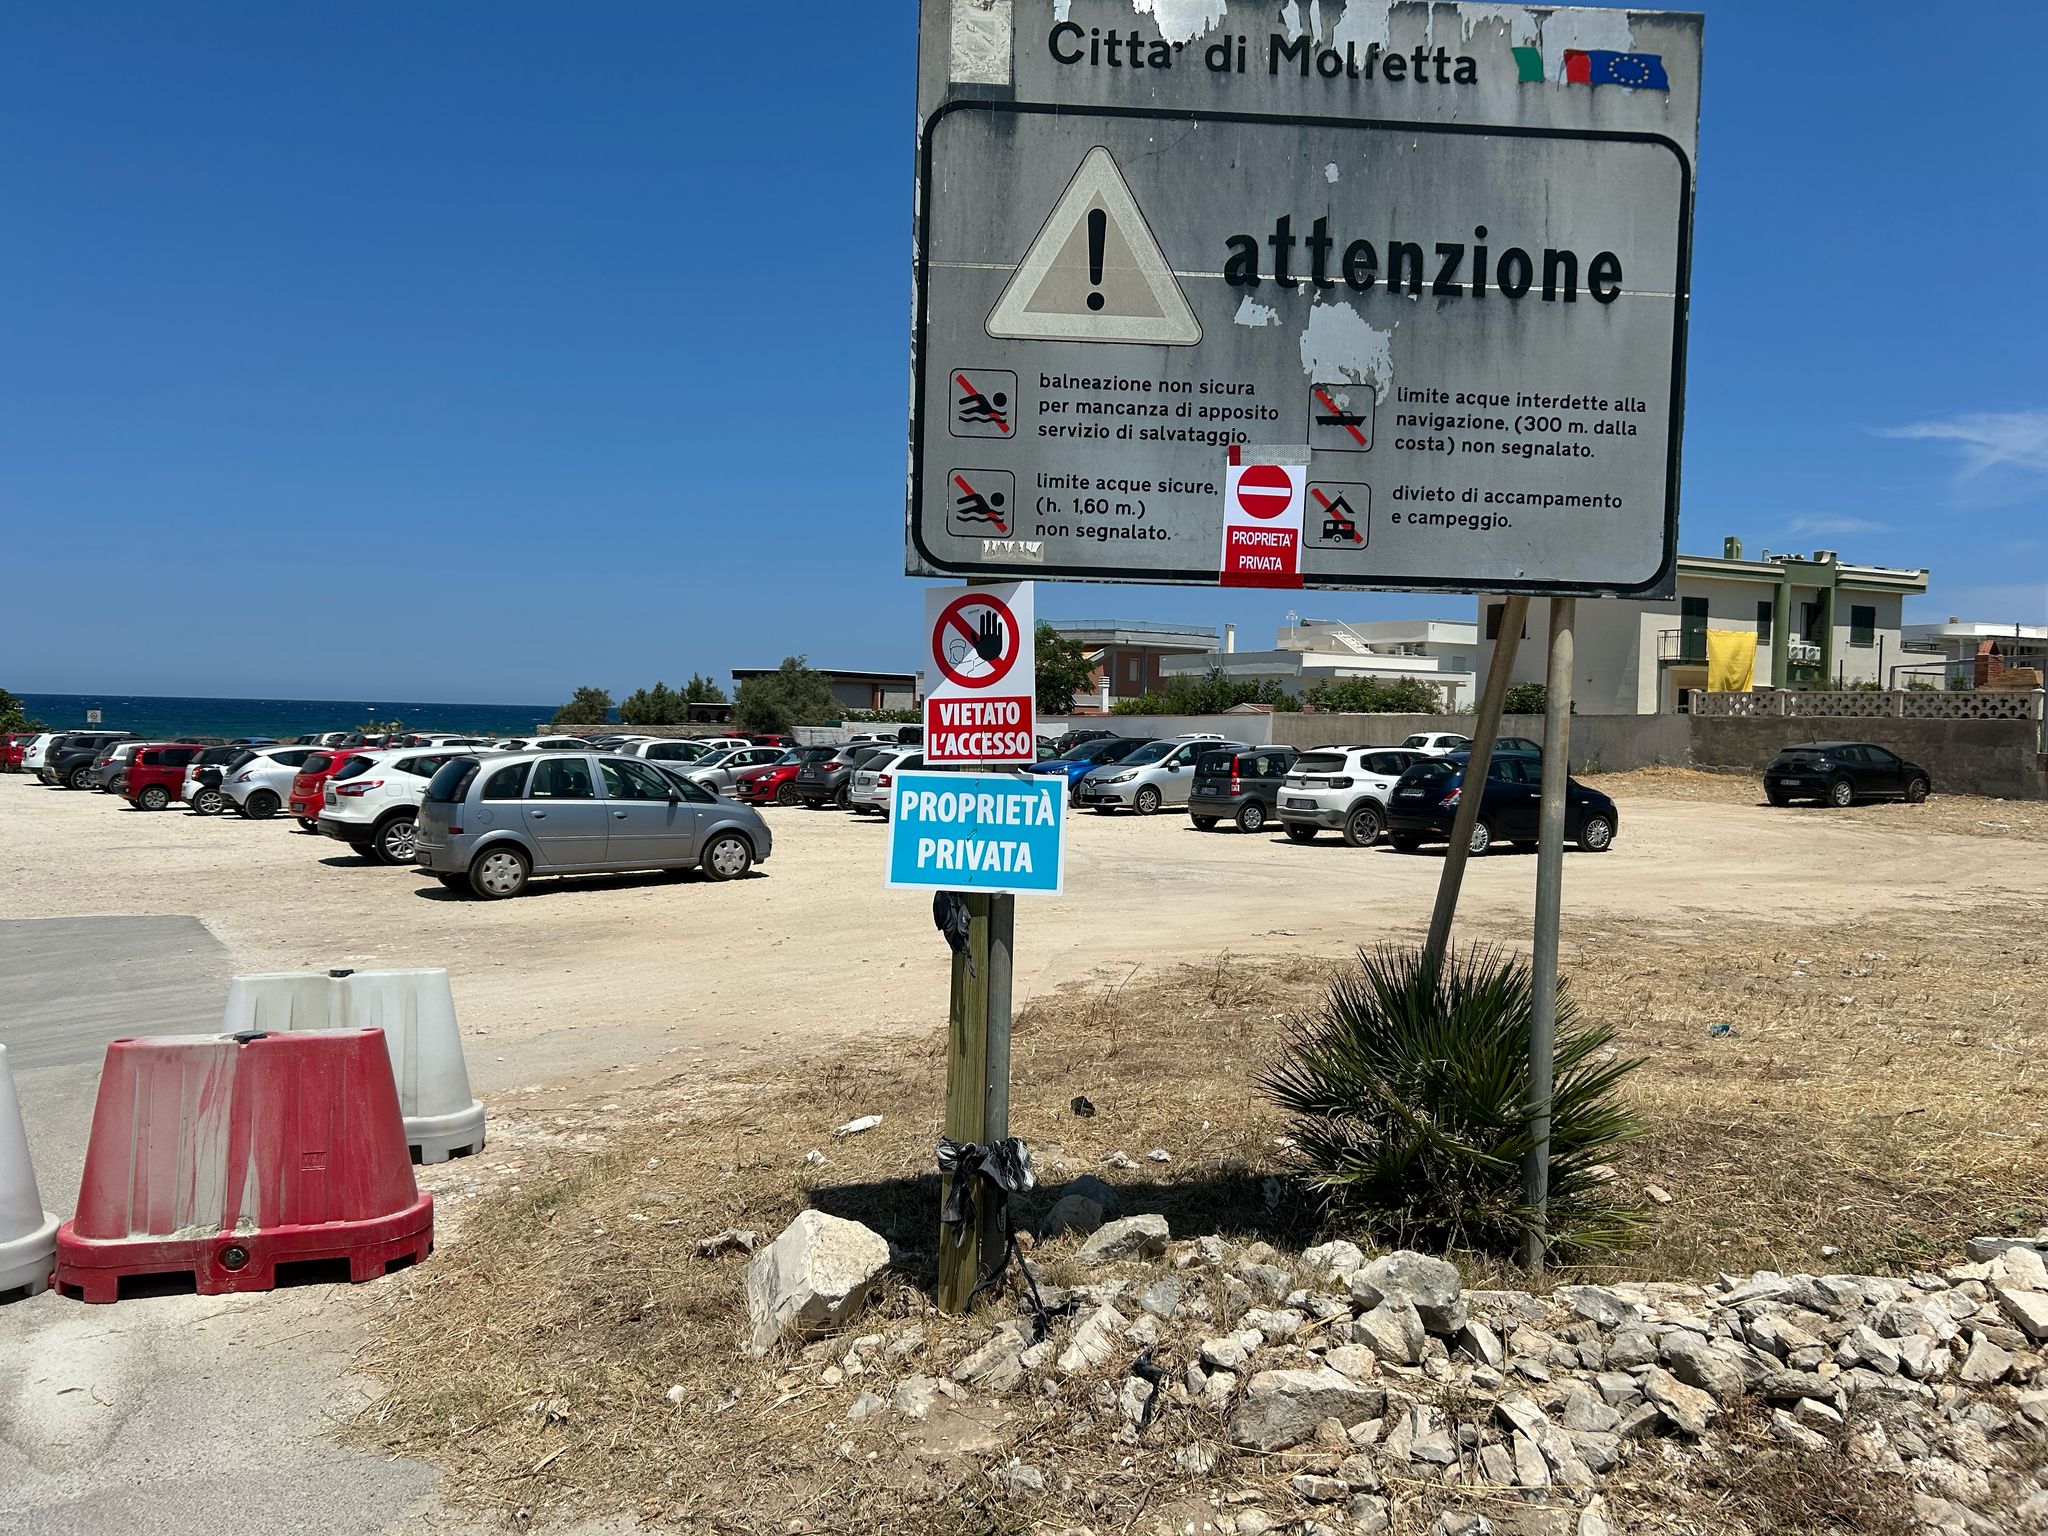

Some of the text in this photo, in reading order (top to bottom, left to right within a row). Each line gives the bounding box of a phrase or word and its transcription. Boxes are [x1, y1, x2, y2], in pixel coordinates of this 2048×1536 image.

[1204, 34, 1247, 74] di
[1269, 33, 1479, 85] Molfetta
[1223, 213, 1624, 304] attenzione
[1039, 373, 1256, 396] balneazione non sicura
[1038, 400, 1280, 422] per mancanza di apposito
[1397, 387, 1647, 413] limite acque interdette alla
[1037, 422, 1251, 447] servizio di salvataggio.
[1514, 415, 1562, 435] (300
[1568, 422, 1588, 434] m.
[1593, 420, 1638, 436] dalla
[1394, 437, 1595, 459] costa) non segnalato.
[1036, 472, 1219, 496] limite acque sicure,
[1036, 496, 1146, 520] (h. 1,60 m.)
[1392, 485, 1623, 509] divieto di accampamento
[1035, 524, 1172, 542] non segnalato.
[1391, 512, 1513, 531] e campeggio.
[1239, 555, 1283, 571] PRIVATA
[938, 701, 1020, 726] VIETATO
[931, 731, 1031, 757] L'ACCESSO
[900, 788, 1055, 827] PROPRIETÀ
[916, 838, 1033, 873] PRIVATA
